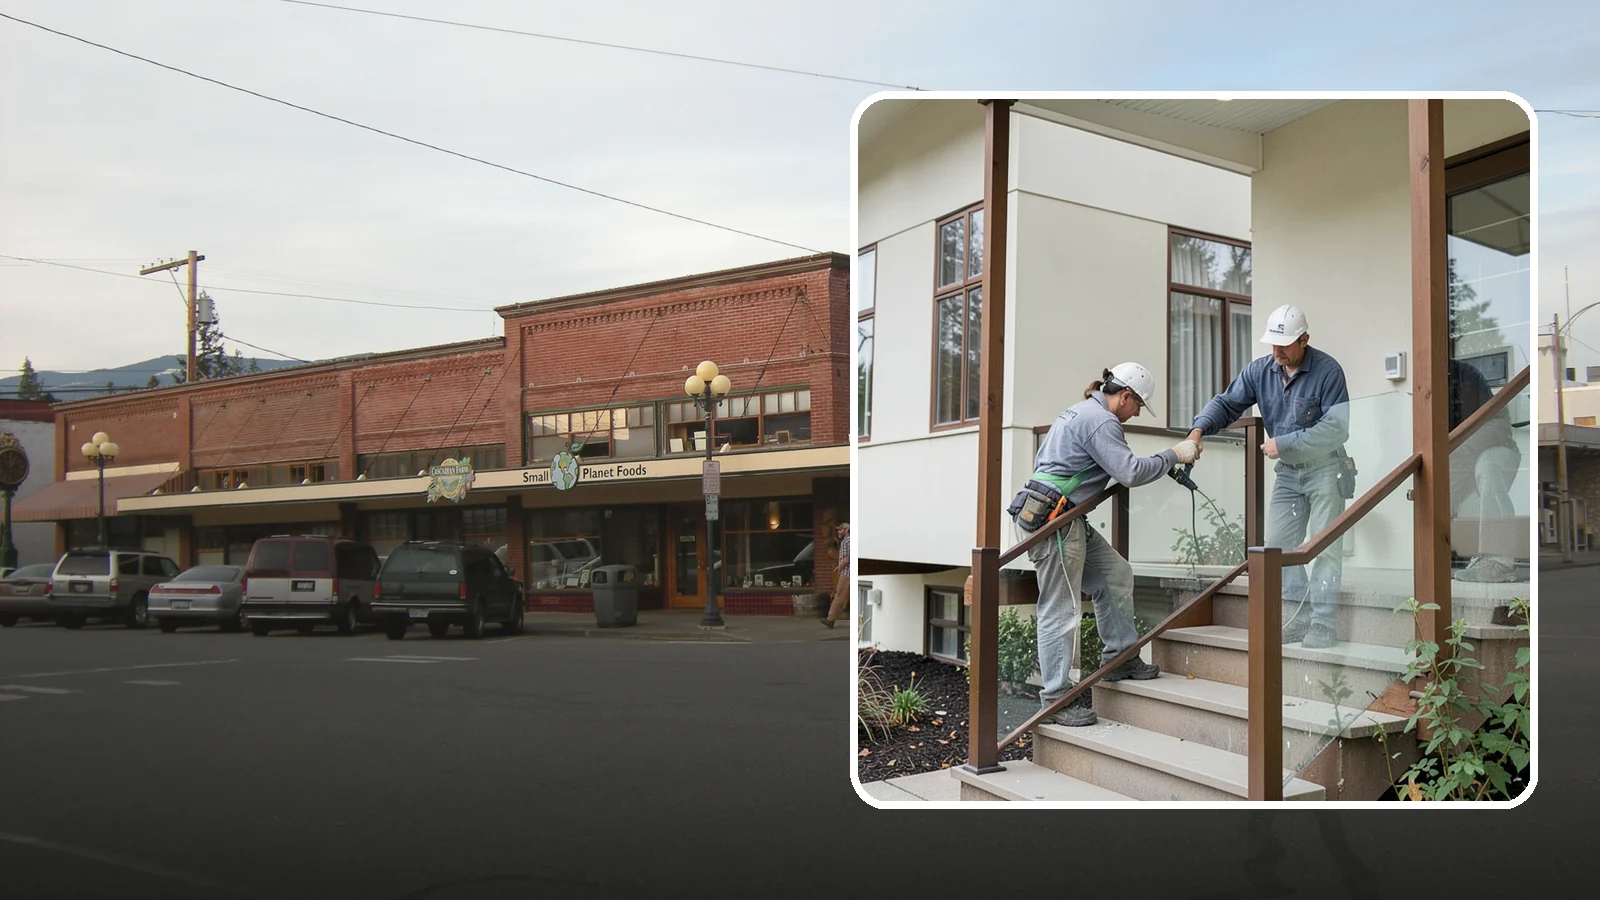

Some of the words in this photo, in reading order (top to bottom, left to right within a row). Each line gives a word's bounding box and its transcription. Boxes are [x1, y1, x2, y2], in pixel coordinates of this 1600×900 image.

[523, 471, 549, 483] Small
[582, 467, 614, 479] Planet
[617, 464, 647, 477] Foods
